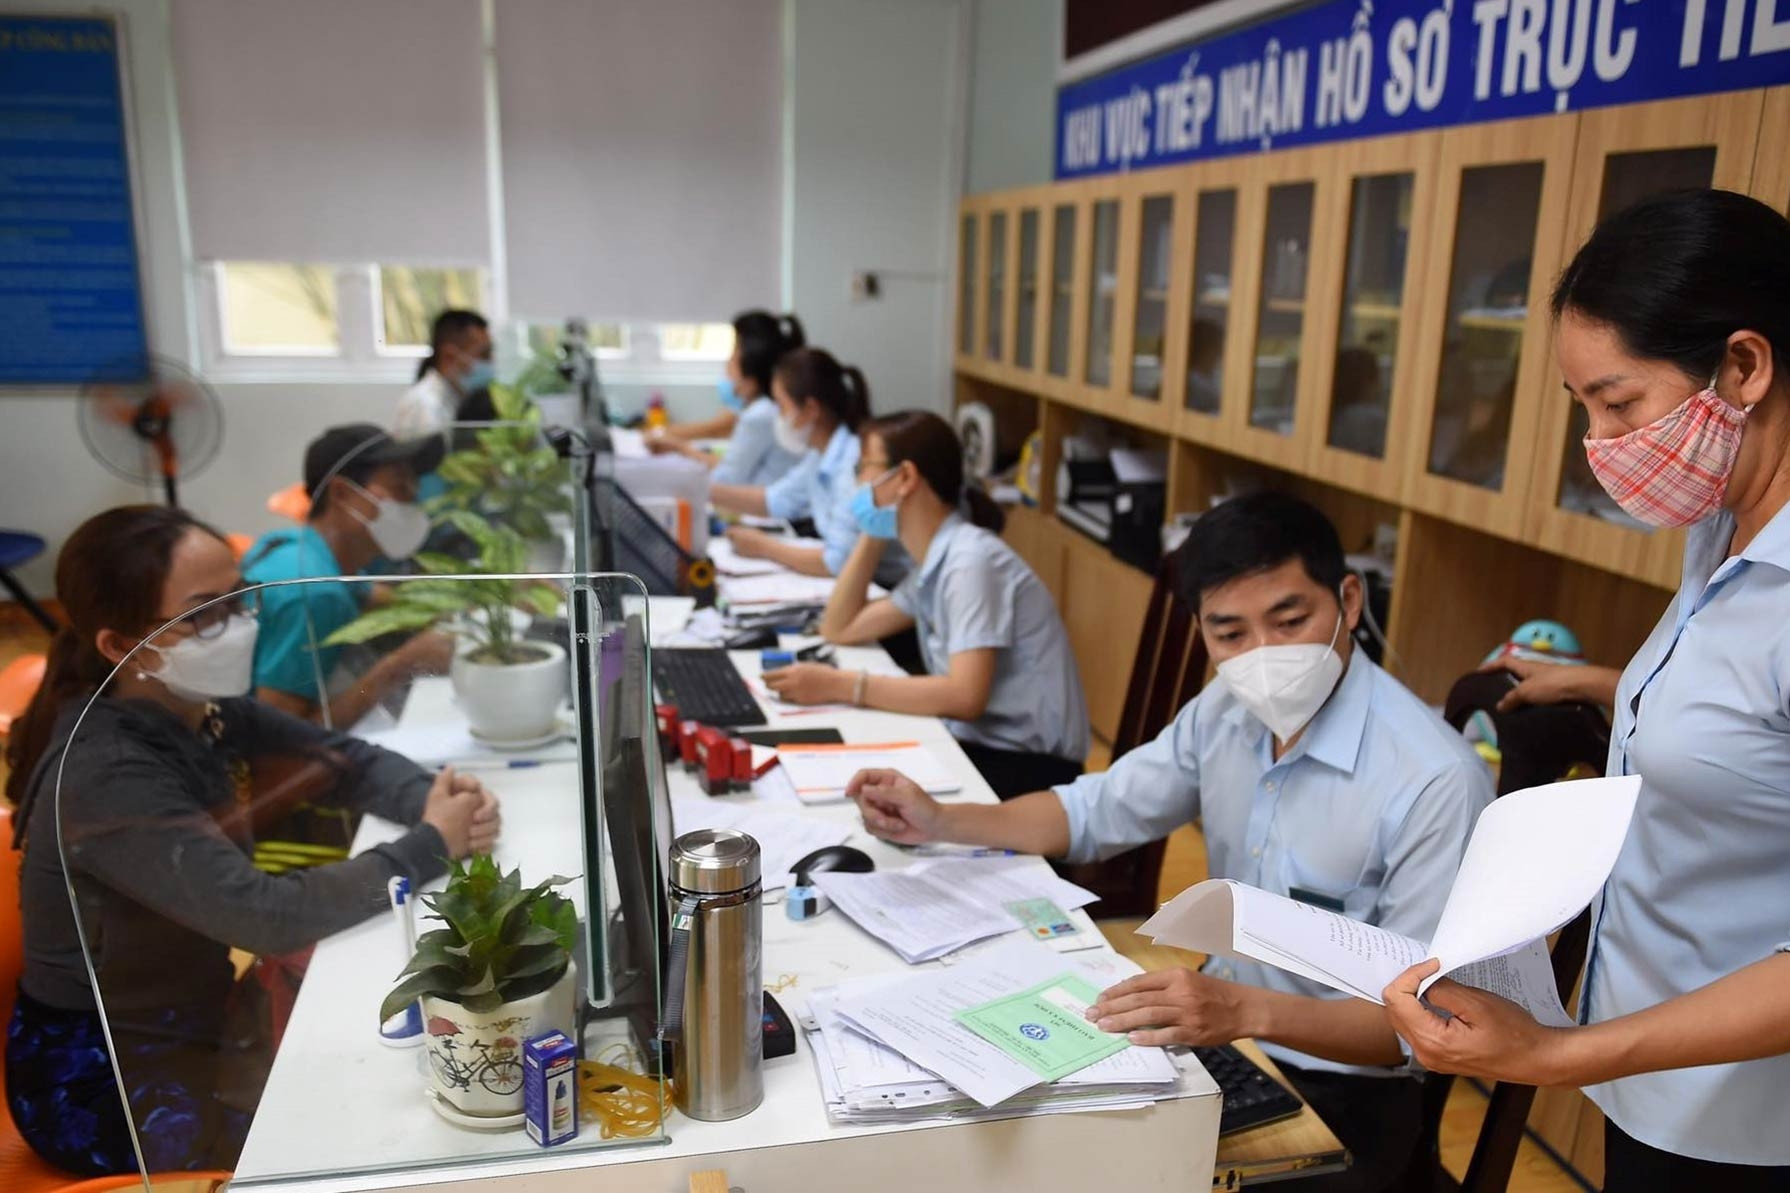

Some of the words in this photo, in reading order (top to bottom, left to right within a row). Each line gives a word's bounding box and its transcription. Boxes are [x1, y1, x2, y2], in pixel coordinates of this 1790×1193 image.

[1064, 104, 1101, 171] KHU
[1105, 85, 1152, 174] VỰC
[1154, 50, 1214, 154] TIẾP
[1215, 38, 1308, 151] NHẬN
[1315, 0, 1373, 128] HỒ
[1383, 0, 1453, 116] SƠ
